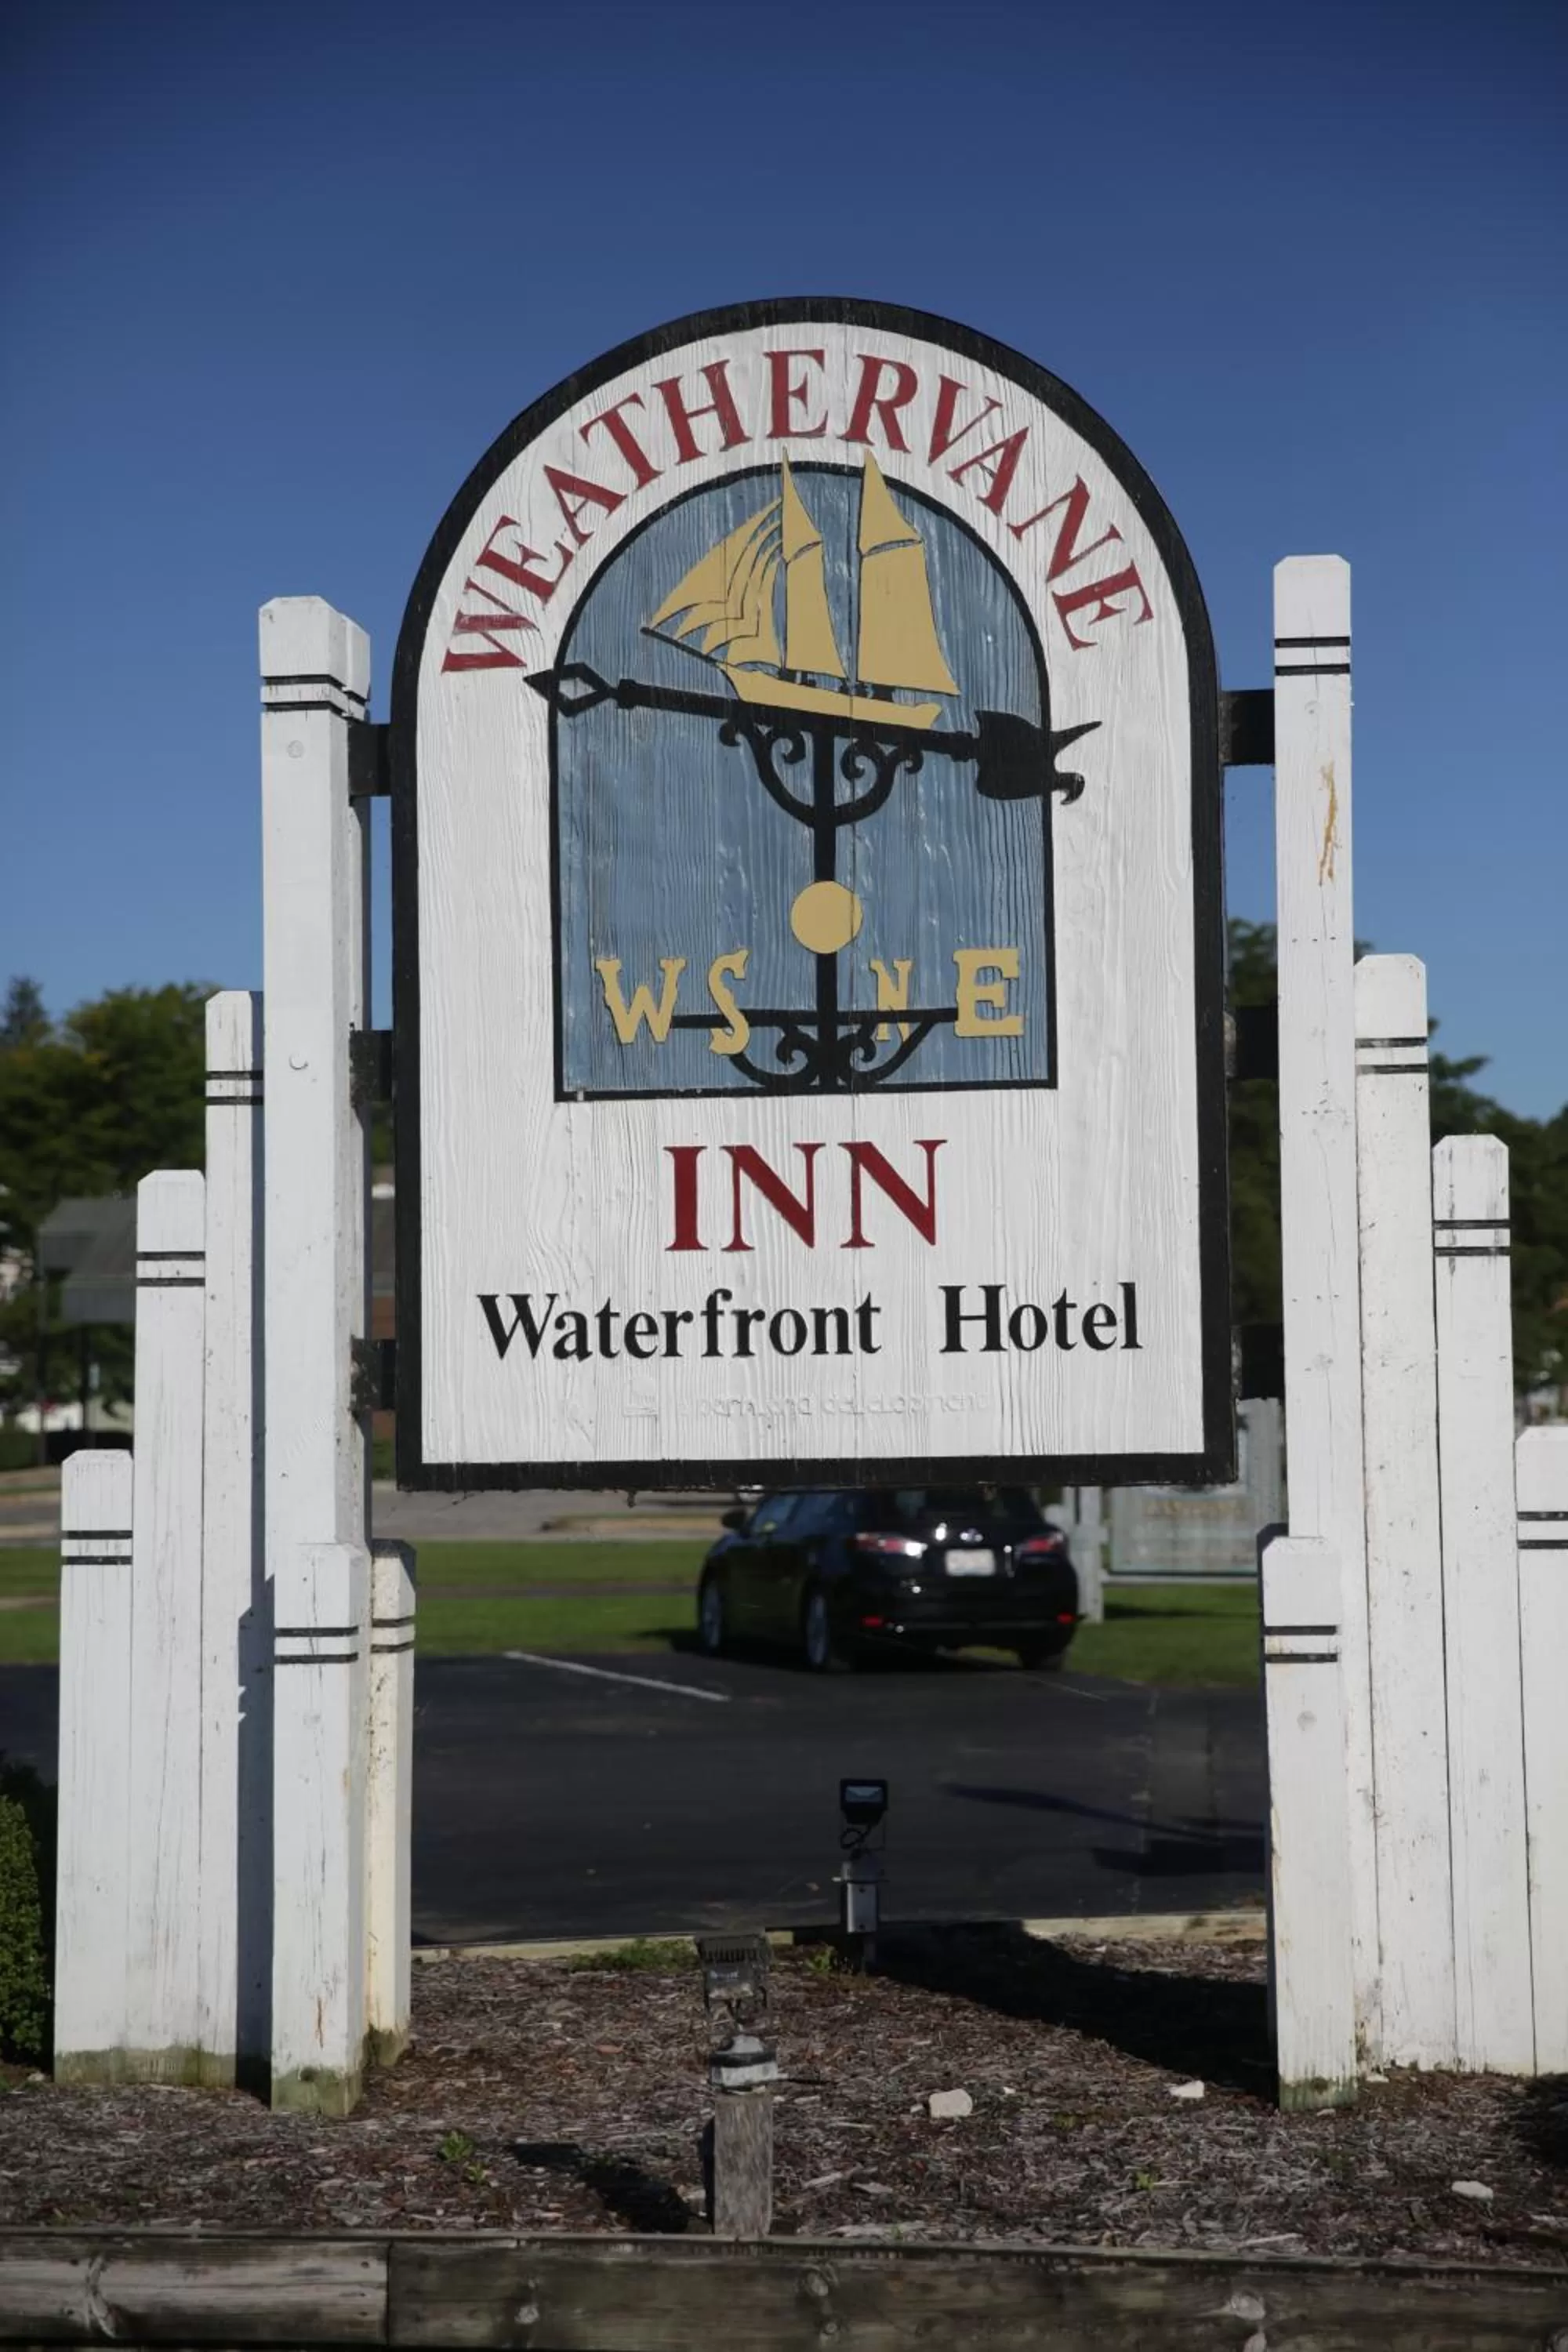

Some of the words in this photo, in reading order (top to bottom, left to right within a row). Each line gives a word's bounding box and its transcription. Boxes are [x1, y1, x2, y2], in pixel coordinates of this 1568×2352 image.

[441, 349, 1153, 673] WEATHERVANE
[596, 958, 686, 1044] W
[709, 949, 750, 1054] S
[869, 959, 913, 1042] N
[954, 949, 1025, 1037] E
[665, 1139, 947, 1252] INN
[477, 1287, 881, 1363] Waterfront
[939, 1282, 1144, 1354] Hotel
